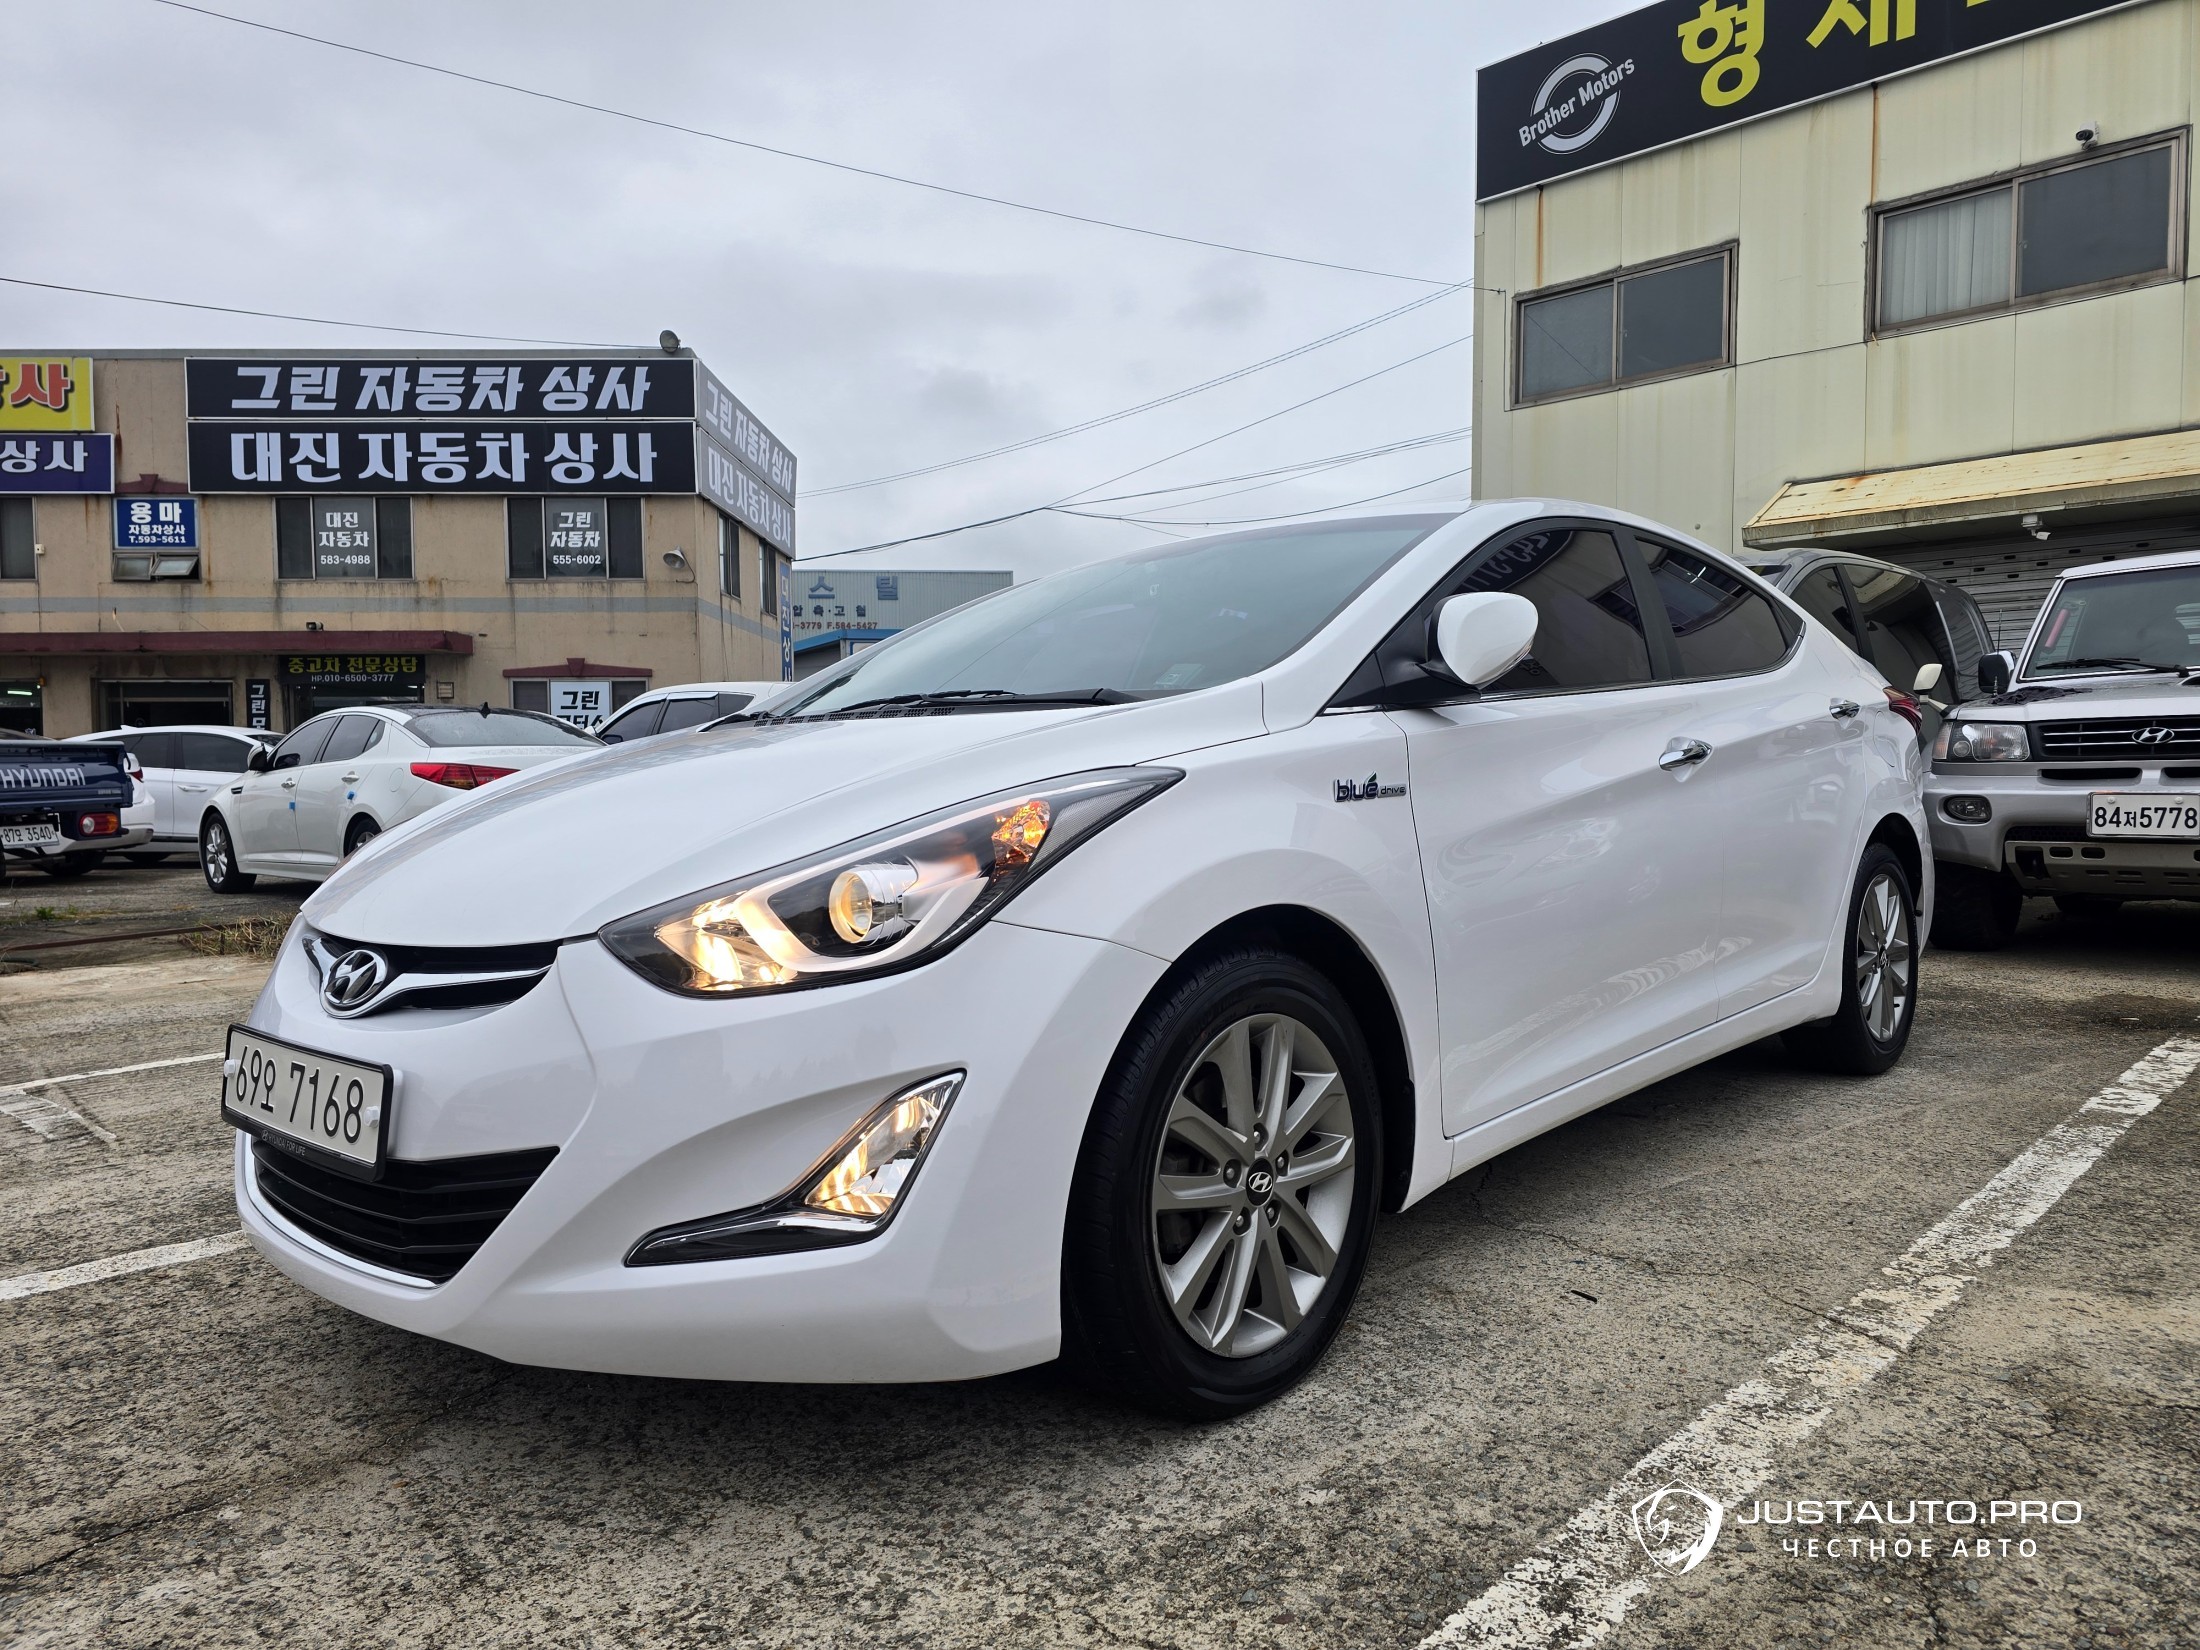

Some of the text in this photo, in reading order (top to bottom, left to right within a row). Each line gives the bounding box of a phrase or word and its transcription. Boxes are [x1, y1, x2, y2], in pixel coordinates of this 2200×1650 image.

[1518, 58, 1635, 147] Brother Motors
[0, 362, 71, 409] 사
[231, 366, 651, 412] 그린 자동차 상사
[705, 379, 794, 494] 그린 자동차 상사
[0, 440, 88, 473] 상사
[230, 432, 658, 484] 대진 자동차 상사
[707, 445, 793, 548] 대진 자동차 상사
[325, 511, 359, 528] 대진
[558, 511, 592, 528] 그린
[128, 524, 186, 535] 자동차상사
[550, 530, 601, 548] 자동차
[128, 535, 187, 544] T.593-5611
[318, 531, 370, 548] 자동차
[320, 554, 371, 565] 583-4988
[552, 554, 602, 565] 555-6002
[288, 656, 419, 674] 중고차 전문상담
[560, 690, 600, 711] 그린
[0, 767, 86, 789] HYUNDAI
[1380, 786, 1406, 796] drive
[2094, 806, 2198, 829] 84저5778
[25, 826, 52, 841] 3540
[236, 1045, 364, 1144] 69오 7168
